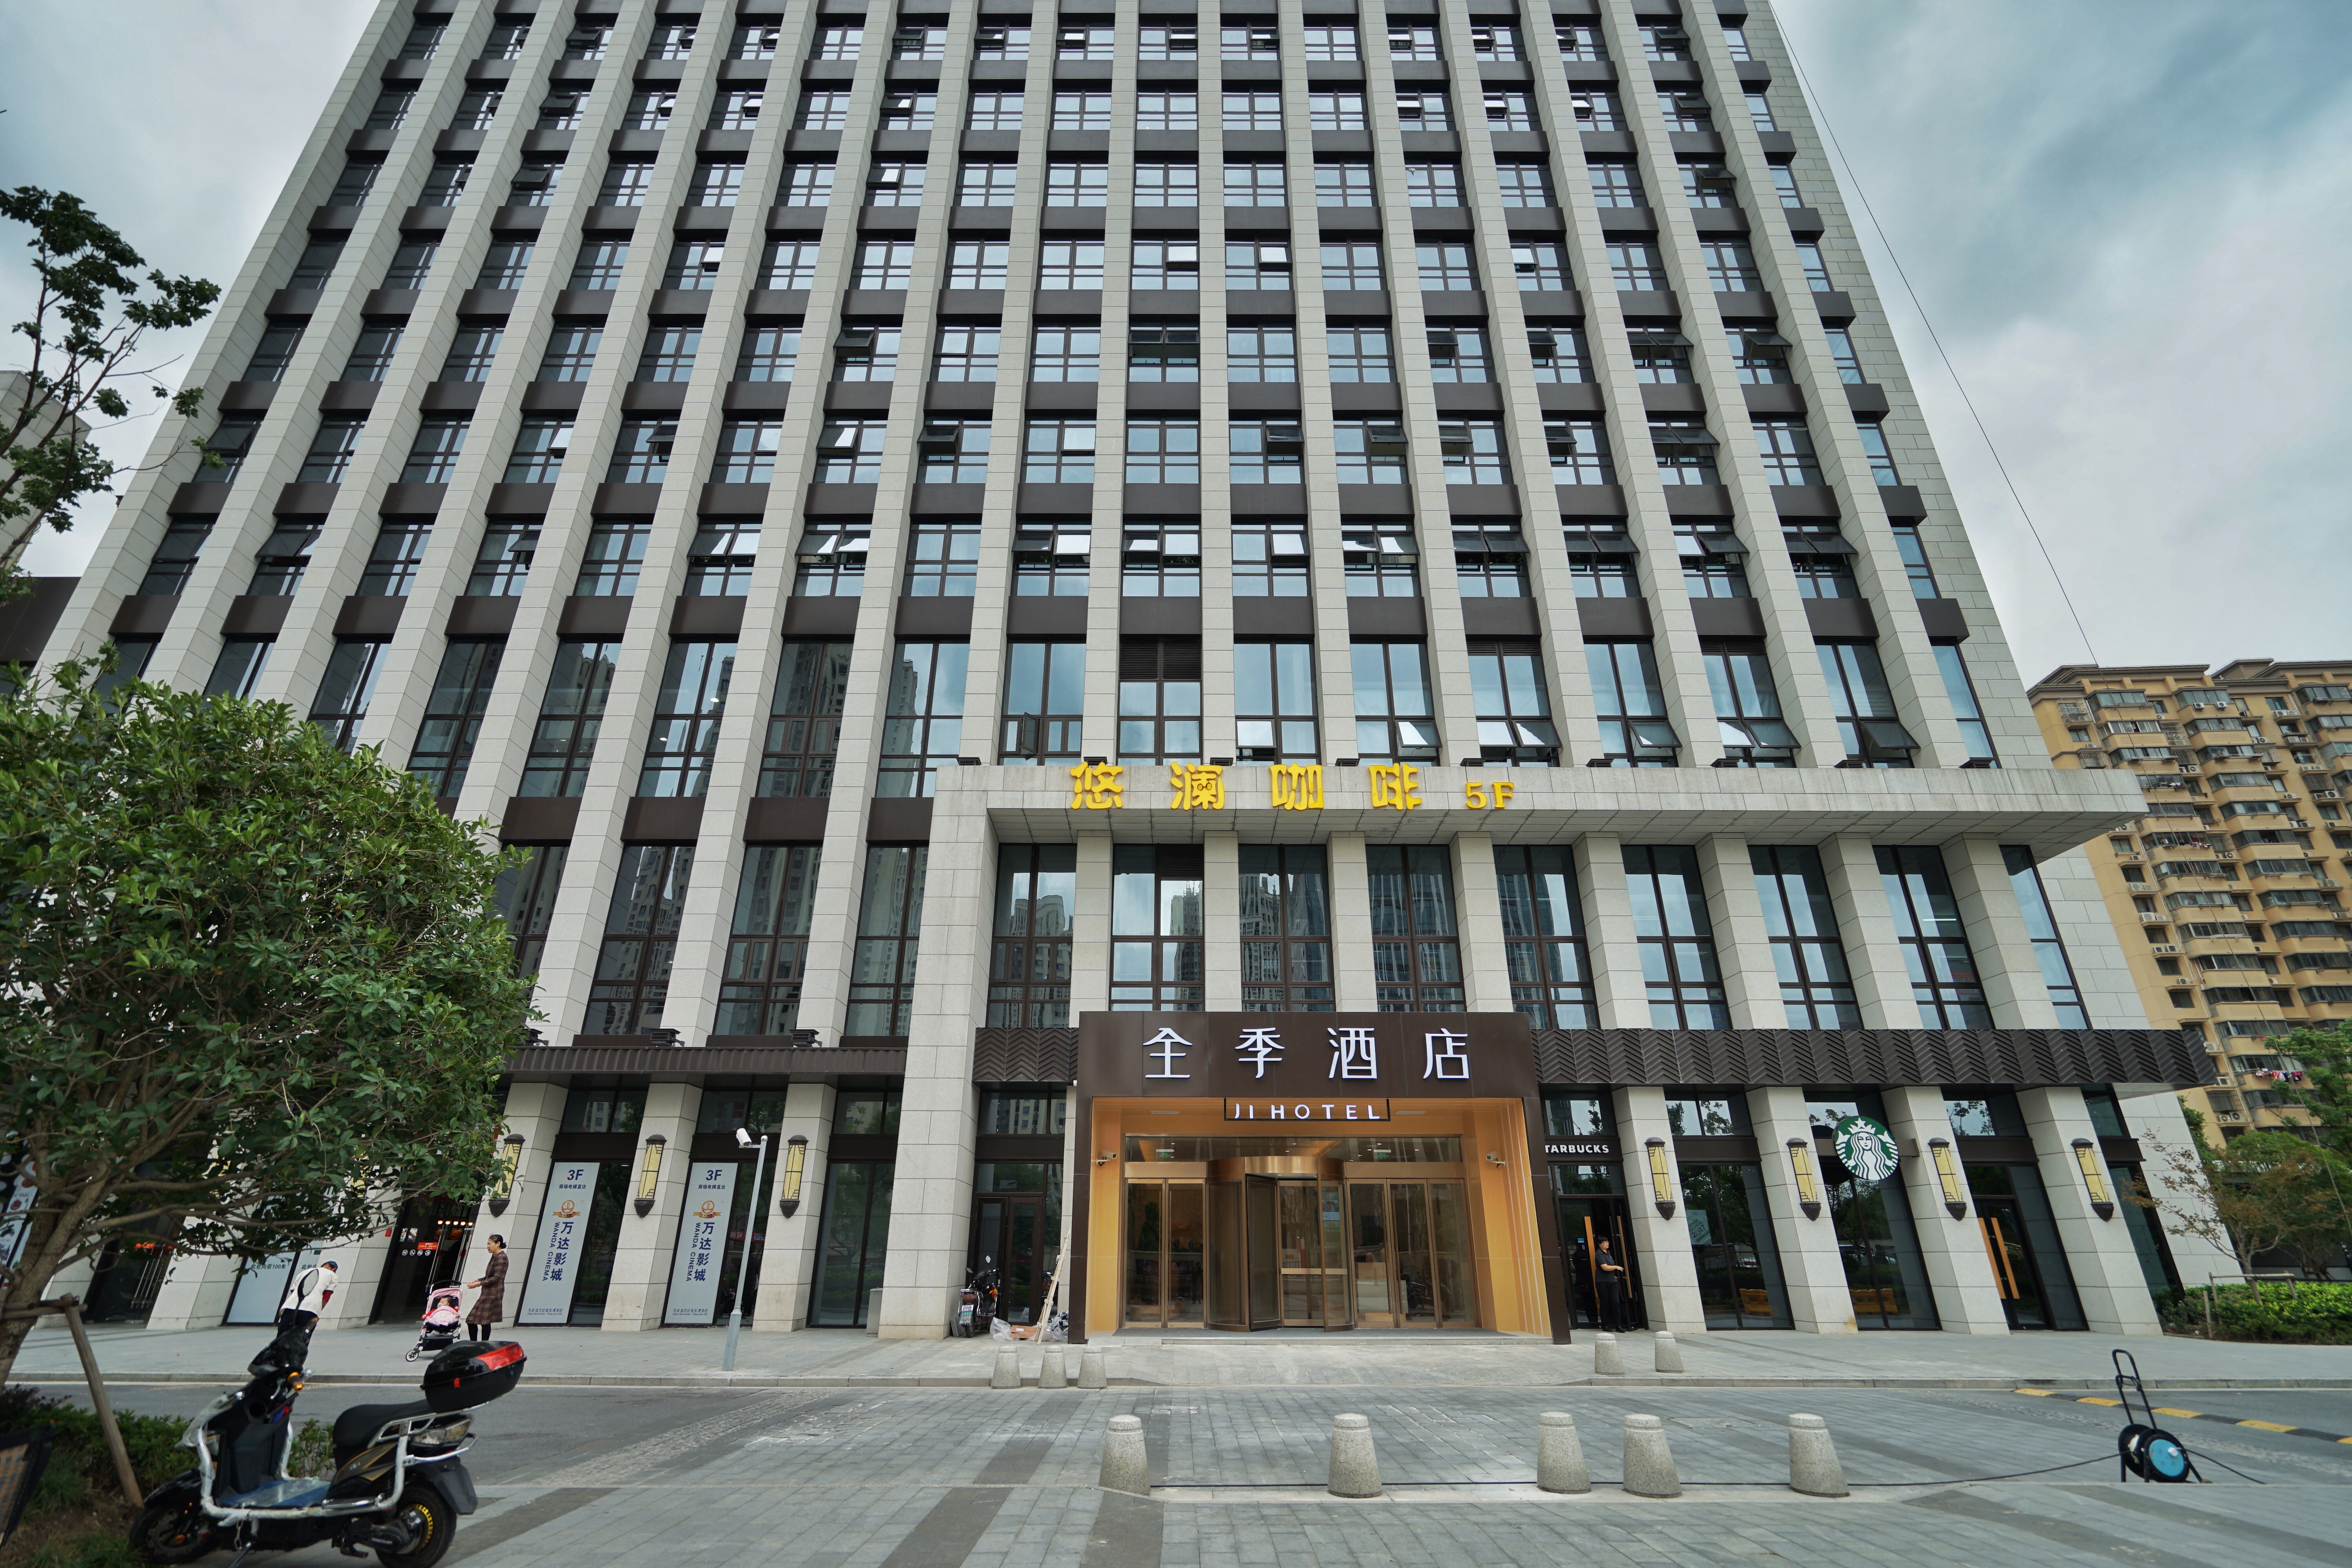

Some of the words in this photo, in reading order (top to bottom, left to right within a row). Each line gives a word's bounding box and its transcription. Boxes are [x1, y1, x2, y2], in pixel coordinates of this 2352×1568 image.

[1069, 761, 1422, 811] 悠澜咖啡
[1465, 782, 1514, 808] 5F
[1143, 1027, 1469, 1079] 全季酒店
[1235, 1103, 1254, 1120] JI
[1271, 1103, 1381, 1120] HOTEL
[1545, 1145, 1609, 1153] TARBUCKS
[567, 1169, 584, 1181] 3F
[706, 1169, 722, 1181] 3F
[550, 1222, 560, 1248] WANDA
[692, 1222, 701, 1248] WANDA
[1691, 1224, 1705, 1238] 2017
[550, 1222, 574, 1281] 万达影城
[693, 1222, 715, 1281] 万达影城
[542, 1252, 553, 1281] CINEMA
[686, 1252, 696, 1282] CINEMA
